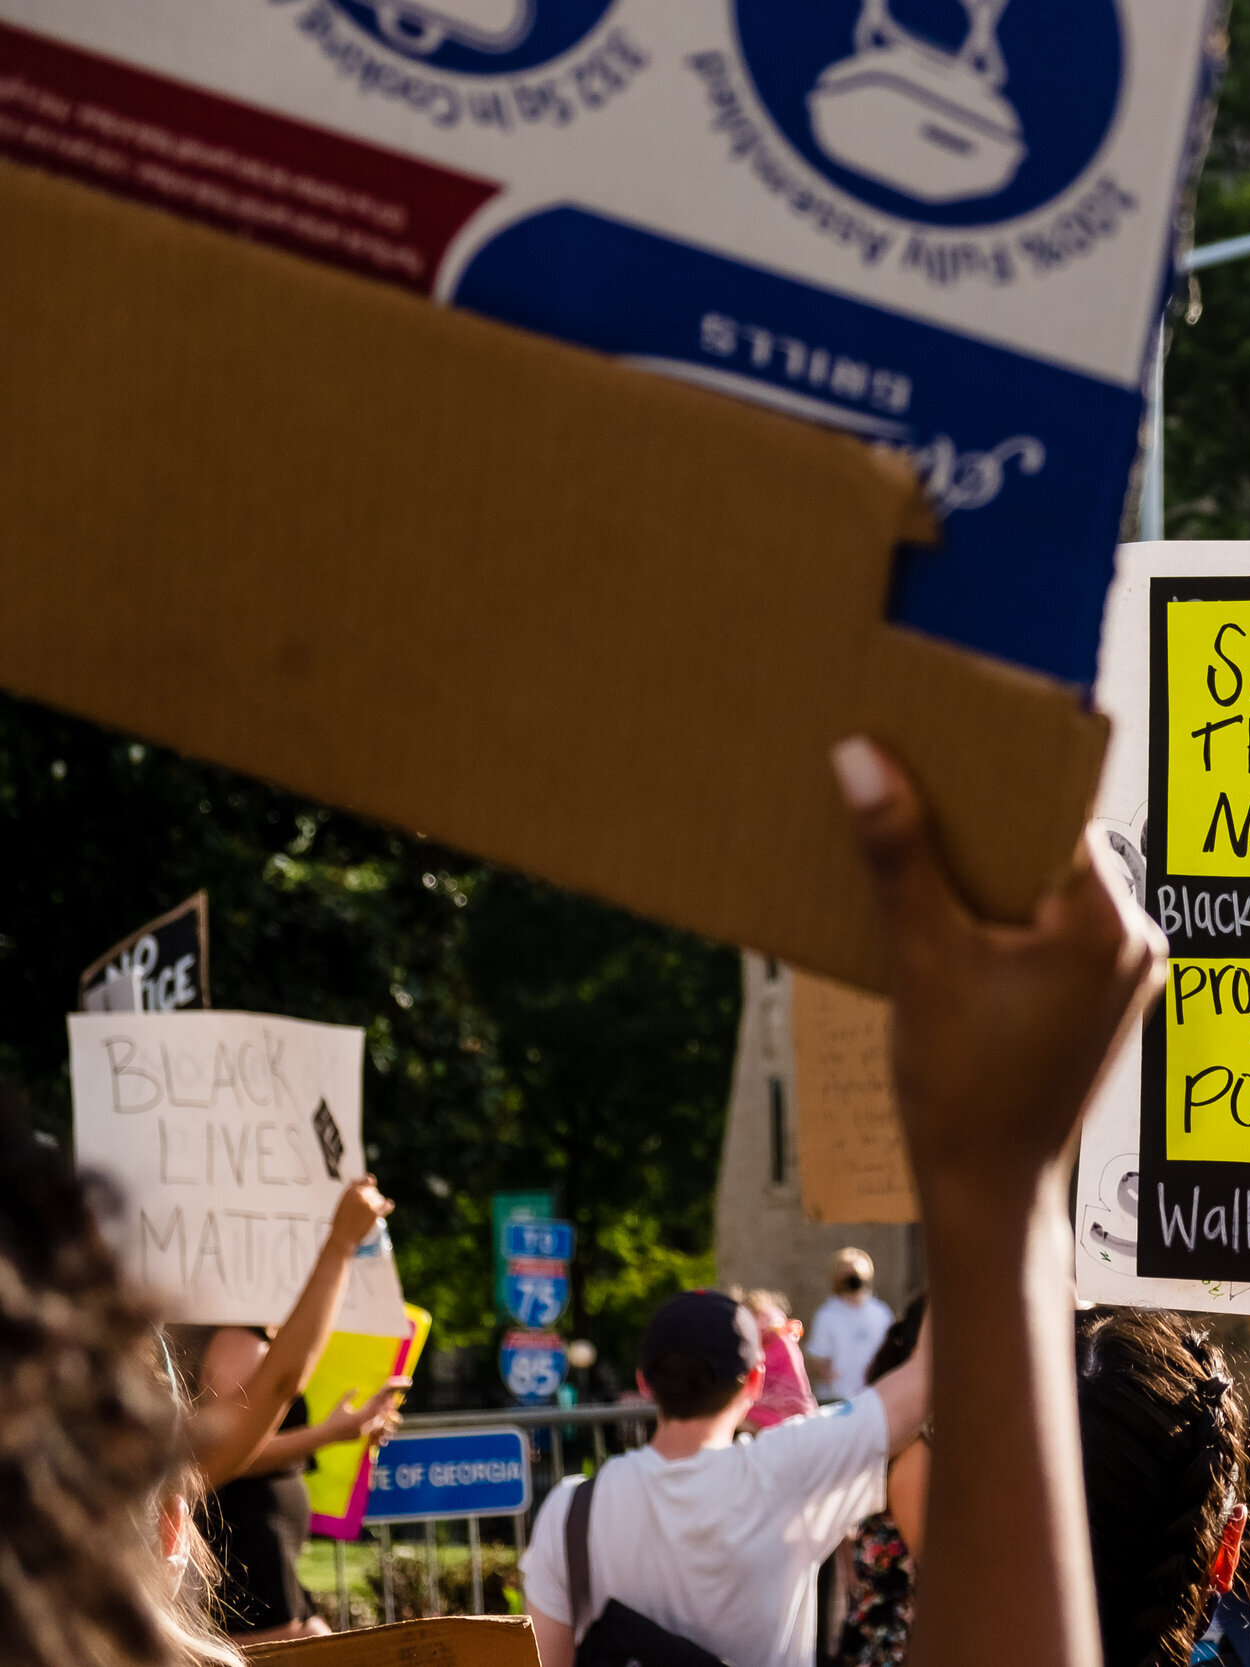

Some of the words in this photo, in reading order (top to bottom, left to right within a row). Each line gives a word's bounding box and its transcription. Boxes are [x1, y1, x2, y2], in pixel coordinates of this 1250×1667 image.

[700, 311, 911, 412] GRILLS
[103, 1026, 300, 1115] BLACK
[157, 1116, 314, 1190] LIVES
[518, 1277, 561, 1325] 75
[508, 1354, 560, 1396] 85
[395, 1463, 423, 1489] OF
[429, 1459, 520, 1487] GEORGIA
